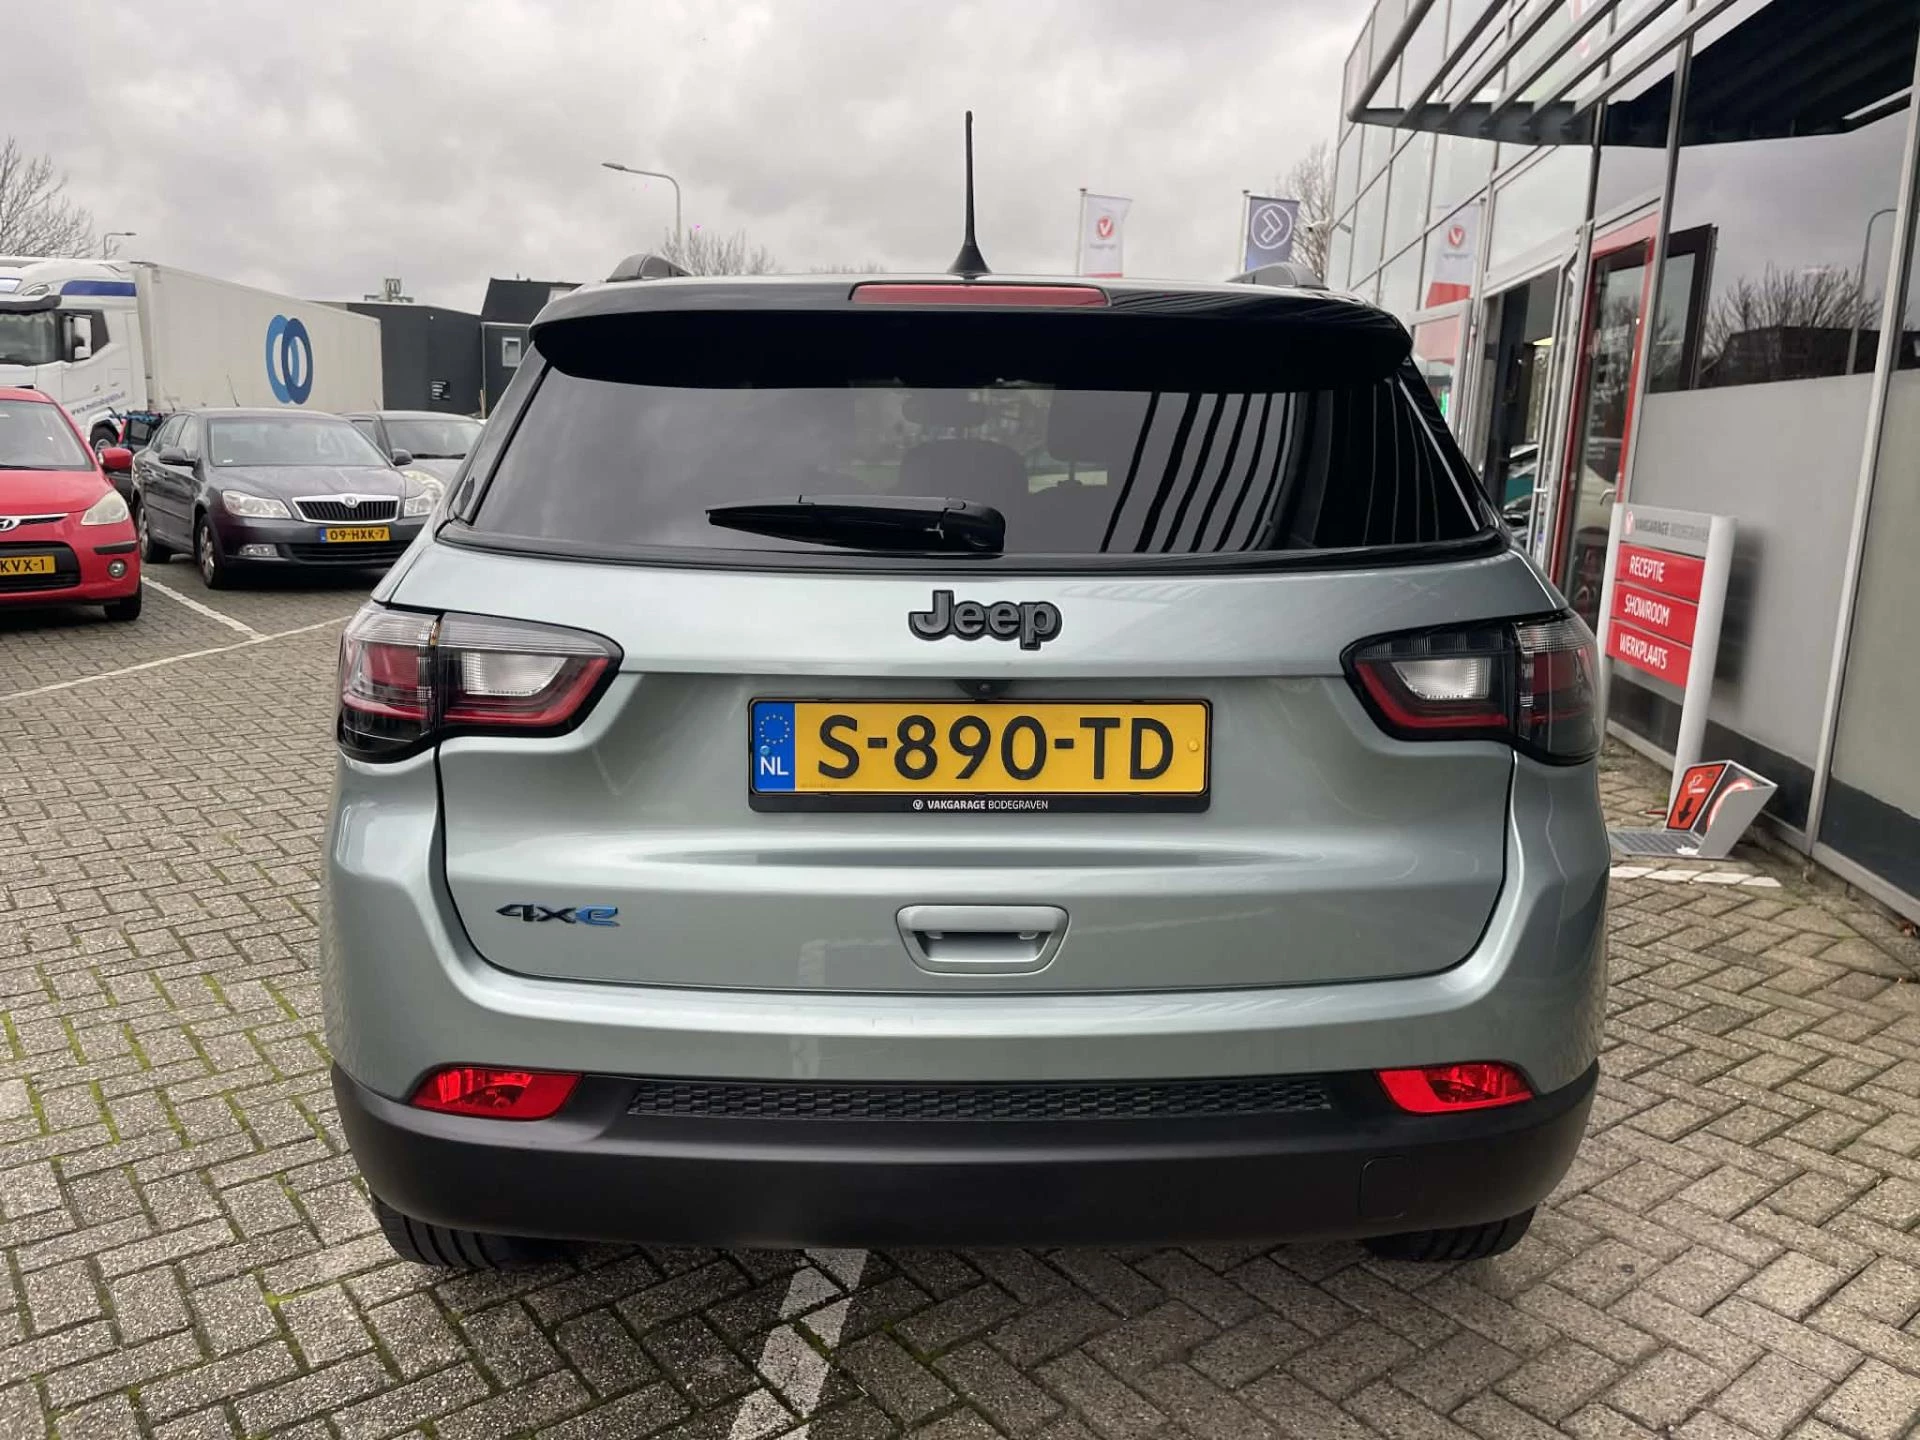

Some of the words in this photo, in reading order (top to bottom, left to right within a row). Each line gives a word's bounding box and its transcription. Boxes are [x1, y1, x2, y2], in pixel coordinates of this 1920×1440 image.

[329, 529, 385, 541] 09-HXK-7
[1629, 555, 1665, 582] RECEPTIE
[908, 589, 1063, 651] Jeep
[1624, 593, 1670, 627] SHOWROOM
[1620, 632, 1668, 670] WERKPLAATS
[817, 714, 1174, 780] S-890-TD
[760, 756, 790, 776] NL
[927, 799, 987, 810] VAKGARAGE
[988, 799, 1049, 810] BODEGRAVEN
